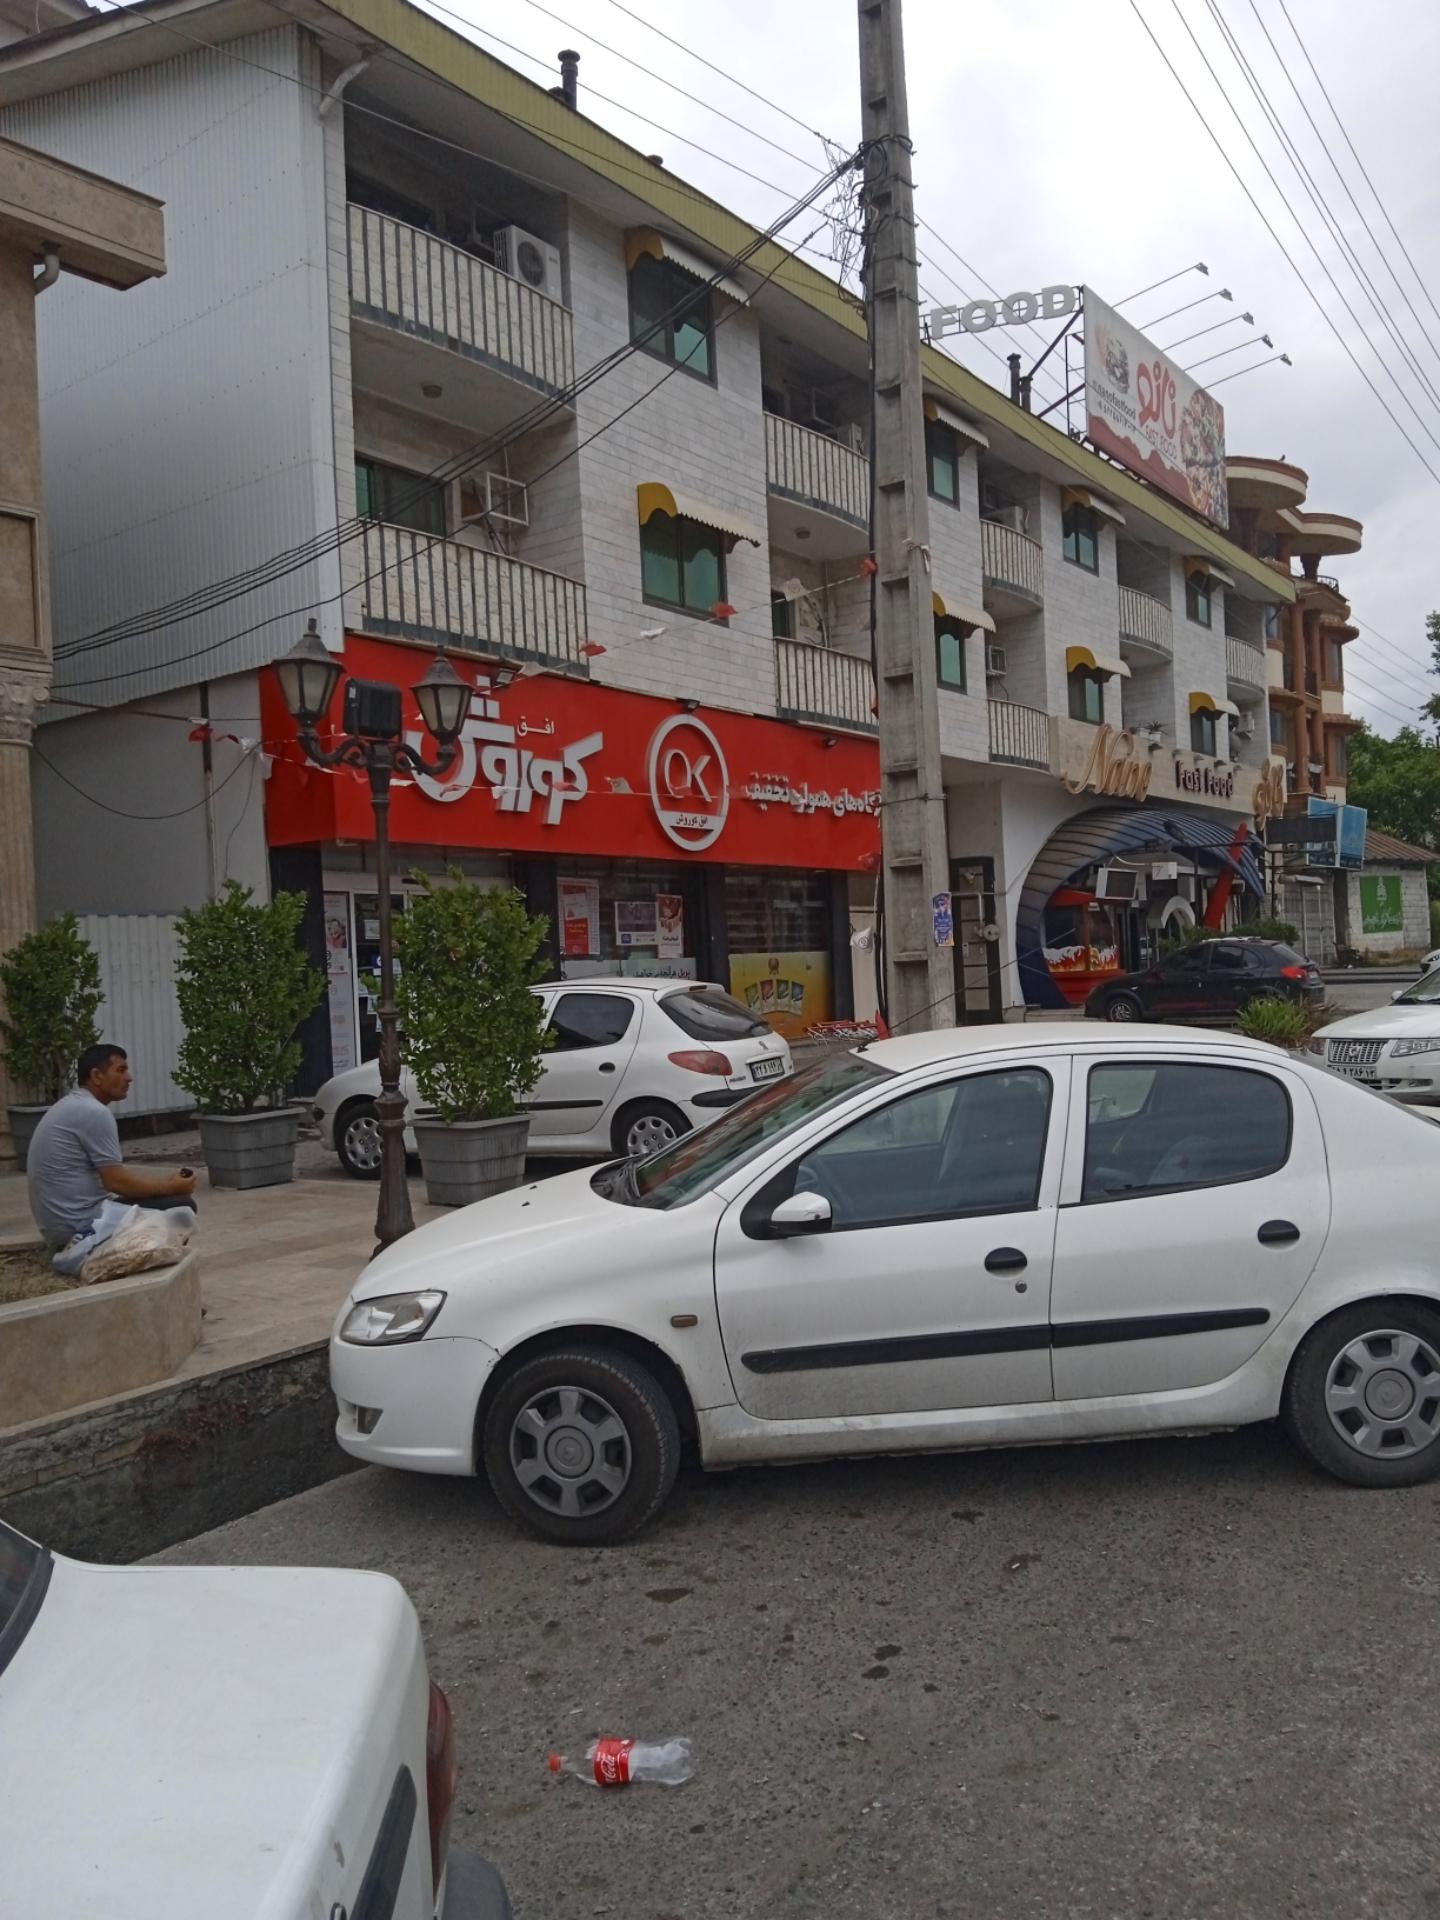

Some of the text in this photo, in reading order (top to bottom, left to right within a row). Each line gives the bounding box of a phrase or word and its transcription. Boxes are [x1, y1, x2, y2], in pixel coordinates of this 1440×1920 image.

[931, 284, 1075, 340] FOOD
[664, 748, 713, 803] OK
[745, 771, 790, 811] تخفیف
[1175, 760, 1235, 799] Fast Food
